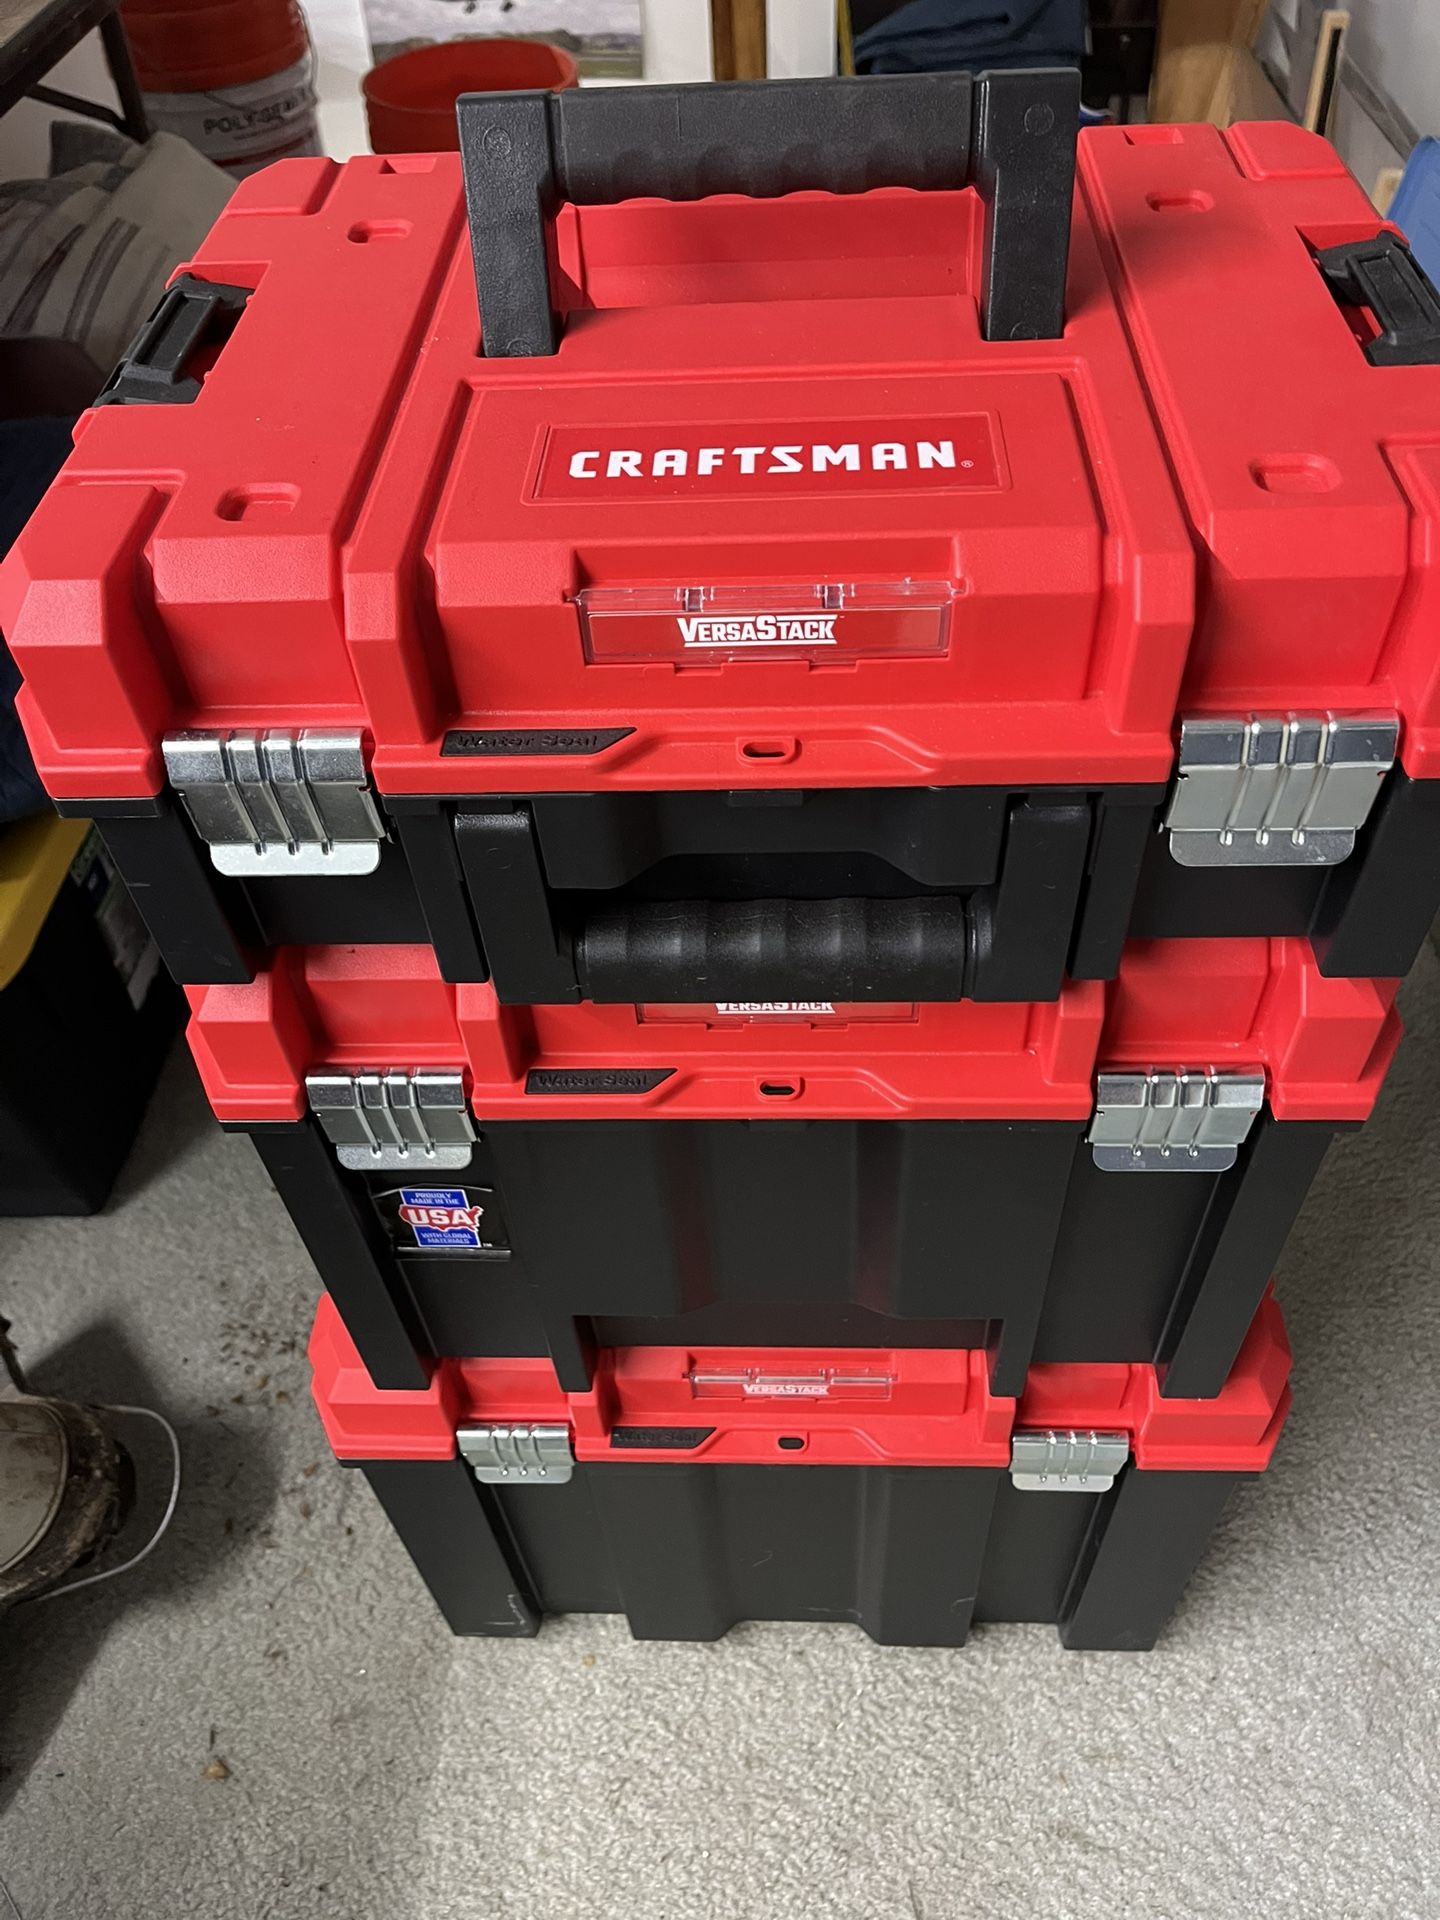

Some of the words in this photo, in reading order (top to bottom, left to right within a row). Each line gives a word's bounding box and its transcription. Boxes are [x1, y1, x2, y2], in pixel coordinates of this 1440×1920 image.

[569, 441, 956, 478] CRAFTSMAN
[677, 615, 837, 646] VERSASTACK
[457, 735, 534, 748] Water
[541, 735, 597, 747] Seal
[407, 1209, 474, 1225] USA
